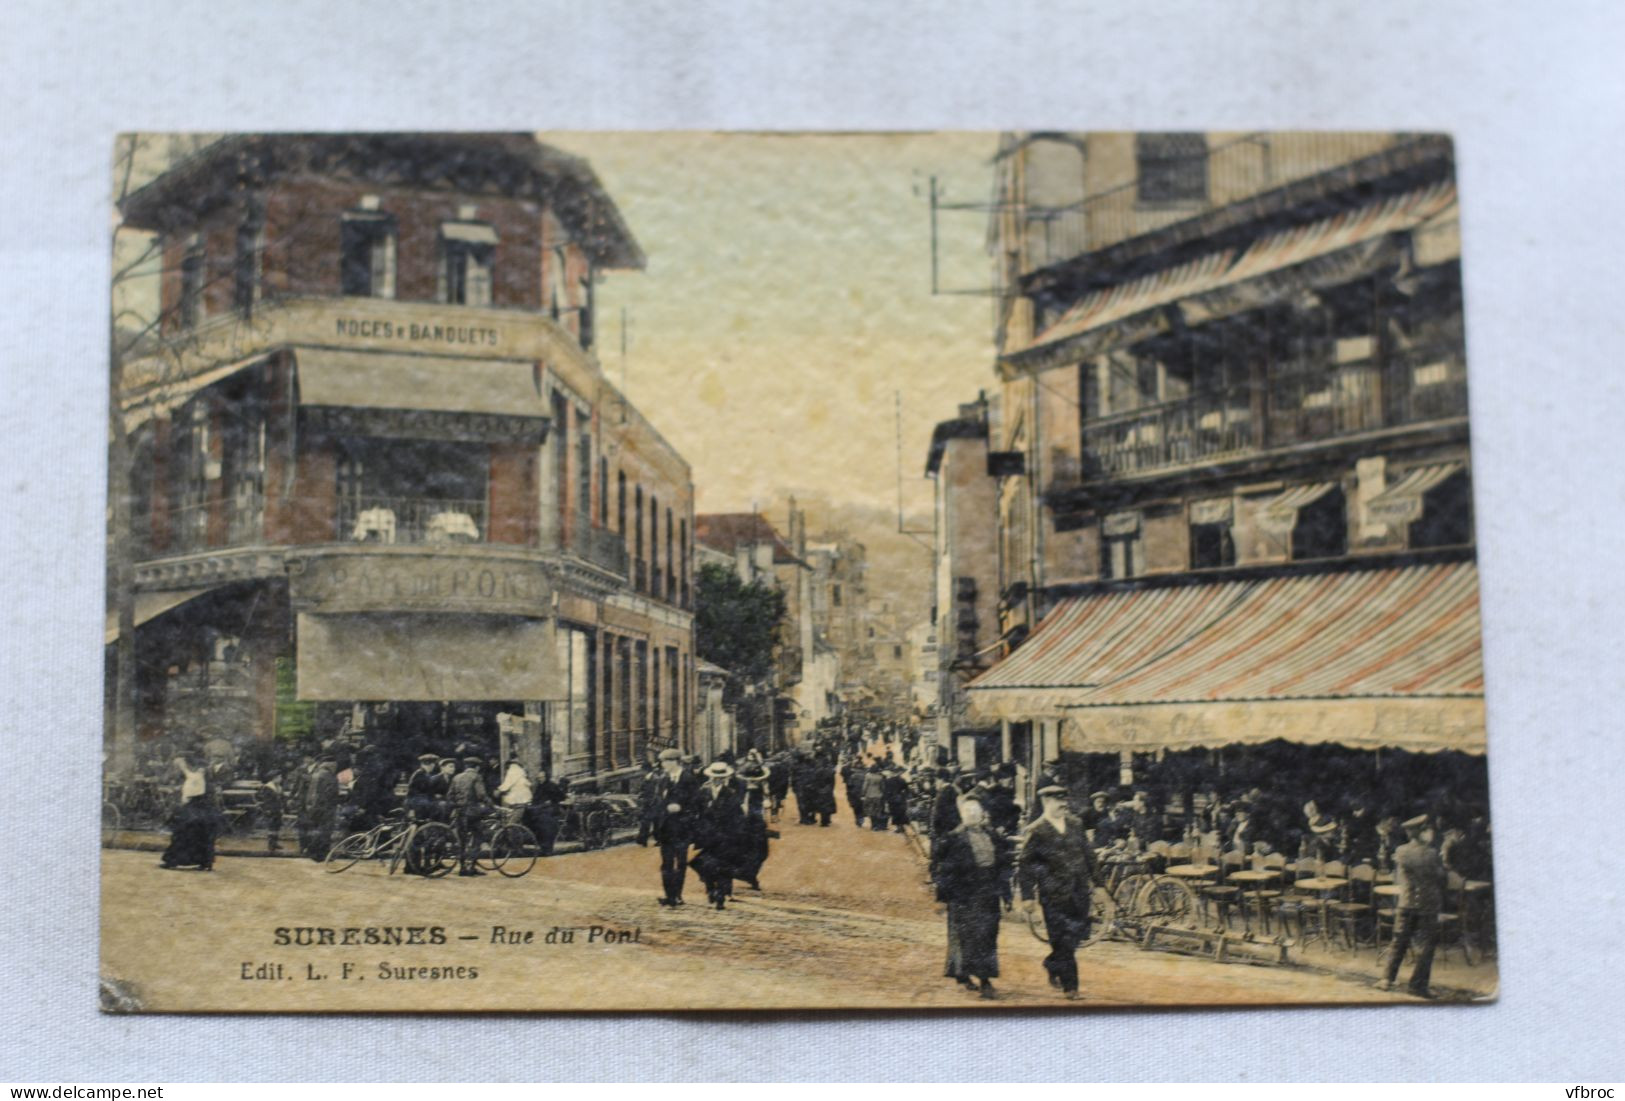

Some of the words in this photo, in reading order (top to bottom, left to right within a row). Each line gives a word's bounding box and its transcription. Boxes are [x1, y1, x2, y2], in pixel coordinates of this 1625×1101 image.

[336, 318, 393, 339] NOCES
[273, 926, 447, 946] SURESNES
[490, 925, 534, 945] Rue
[545, 926, 575, 944] du
[587, 925, 642, 944] Pont
[240, 961, 293, 981] Edit.
[306, 963, 328, 981] L.
[341, 962, 364, 981] F.
[378, 961, 479, 981] Suresnes
